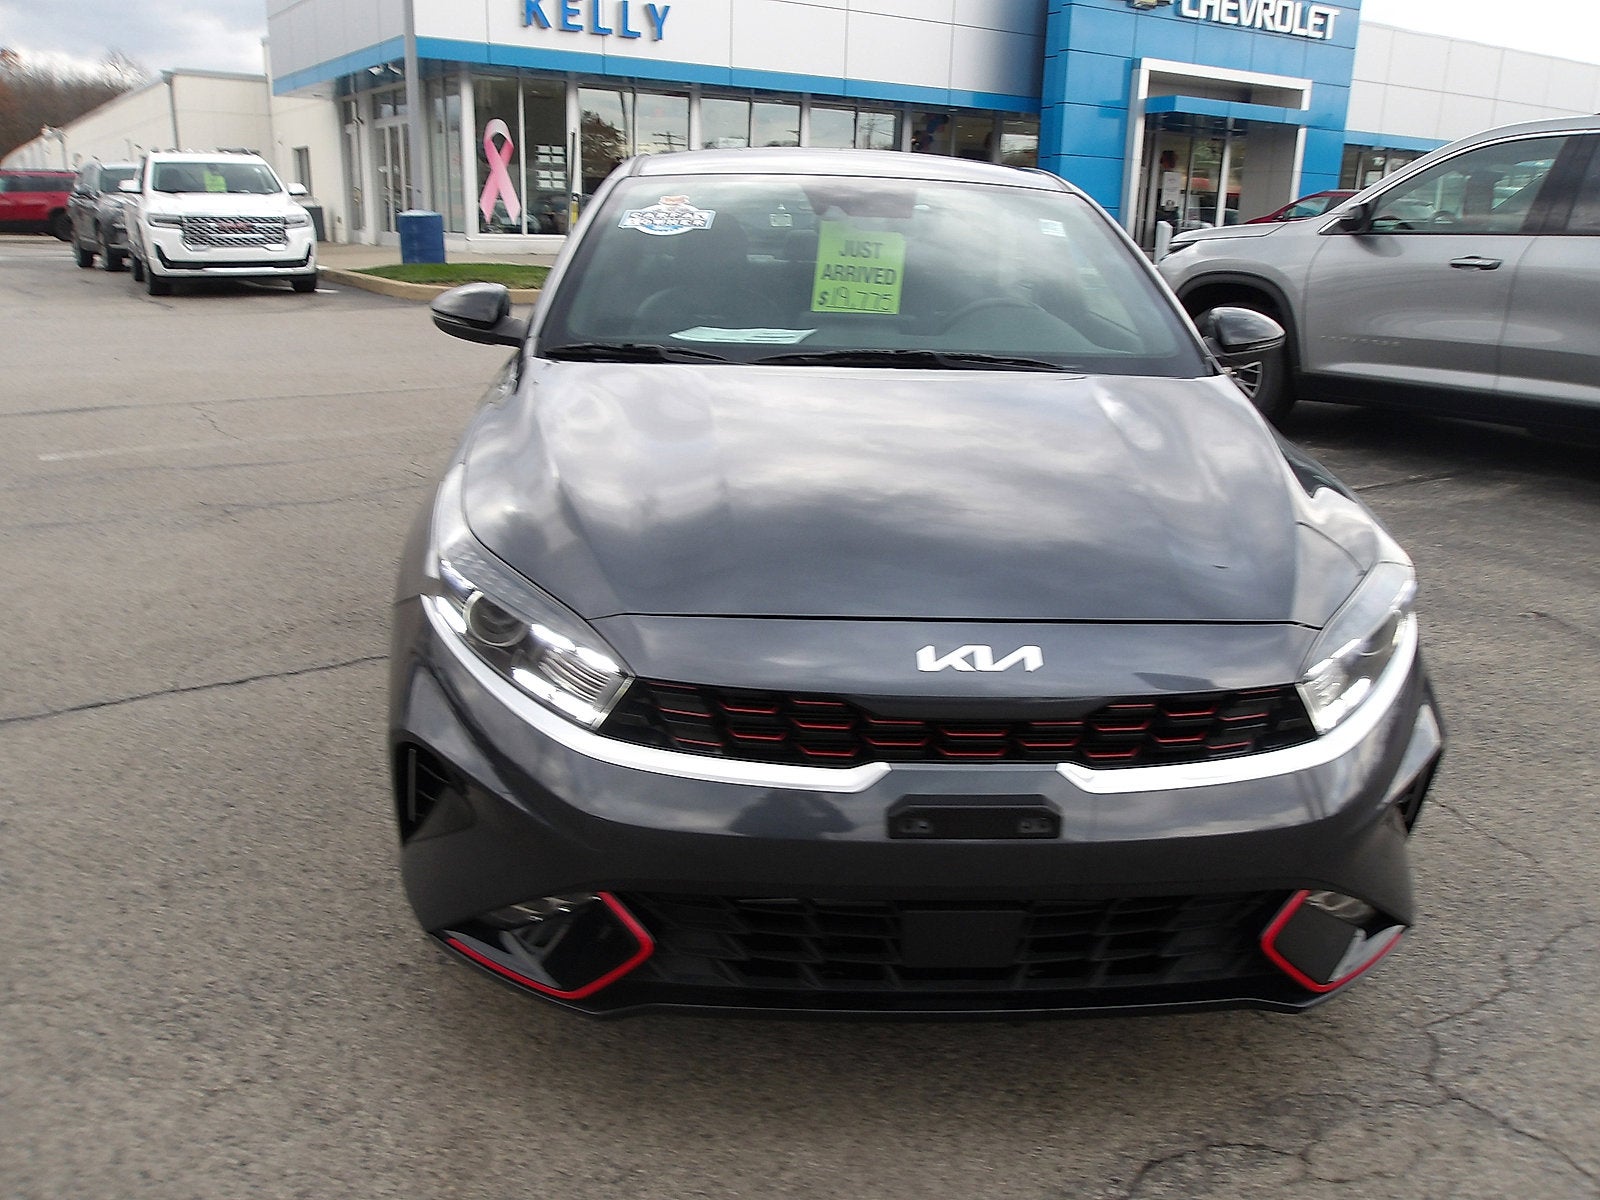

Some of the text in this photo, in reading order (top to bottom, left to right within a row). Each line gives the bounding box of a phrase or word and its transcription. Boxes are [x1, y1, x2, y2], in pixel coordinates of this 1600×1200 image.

[522, 0, 671, 42] KELLY
[1178, 0, 1340, 40] CHEVROLET
[838, 240, 884, 259] JUST
[820, 263, 897, 285] ARRIVED
[916, 644, 1044, 672] KIA
